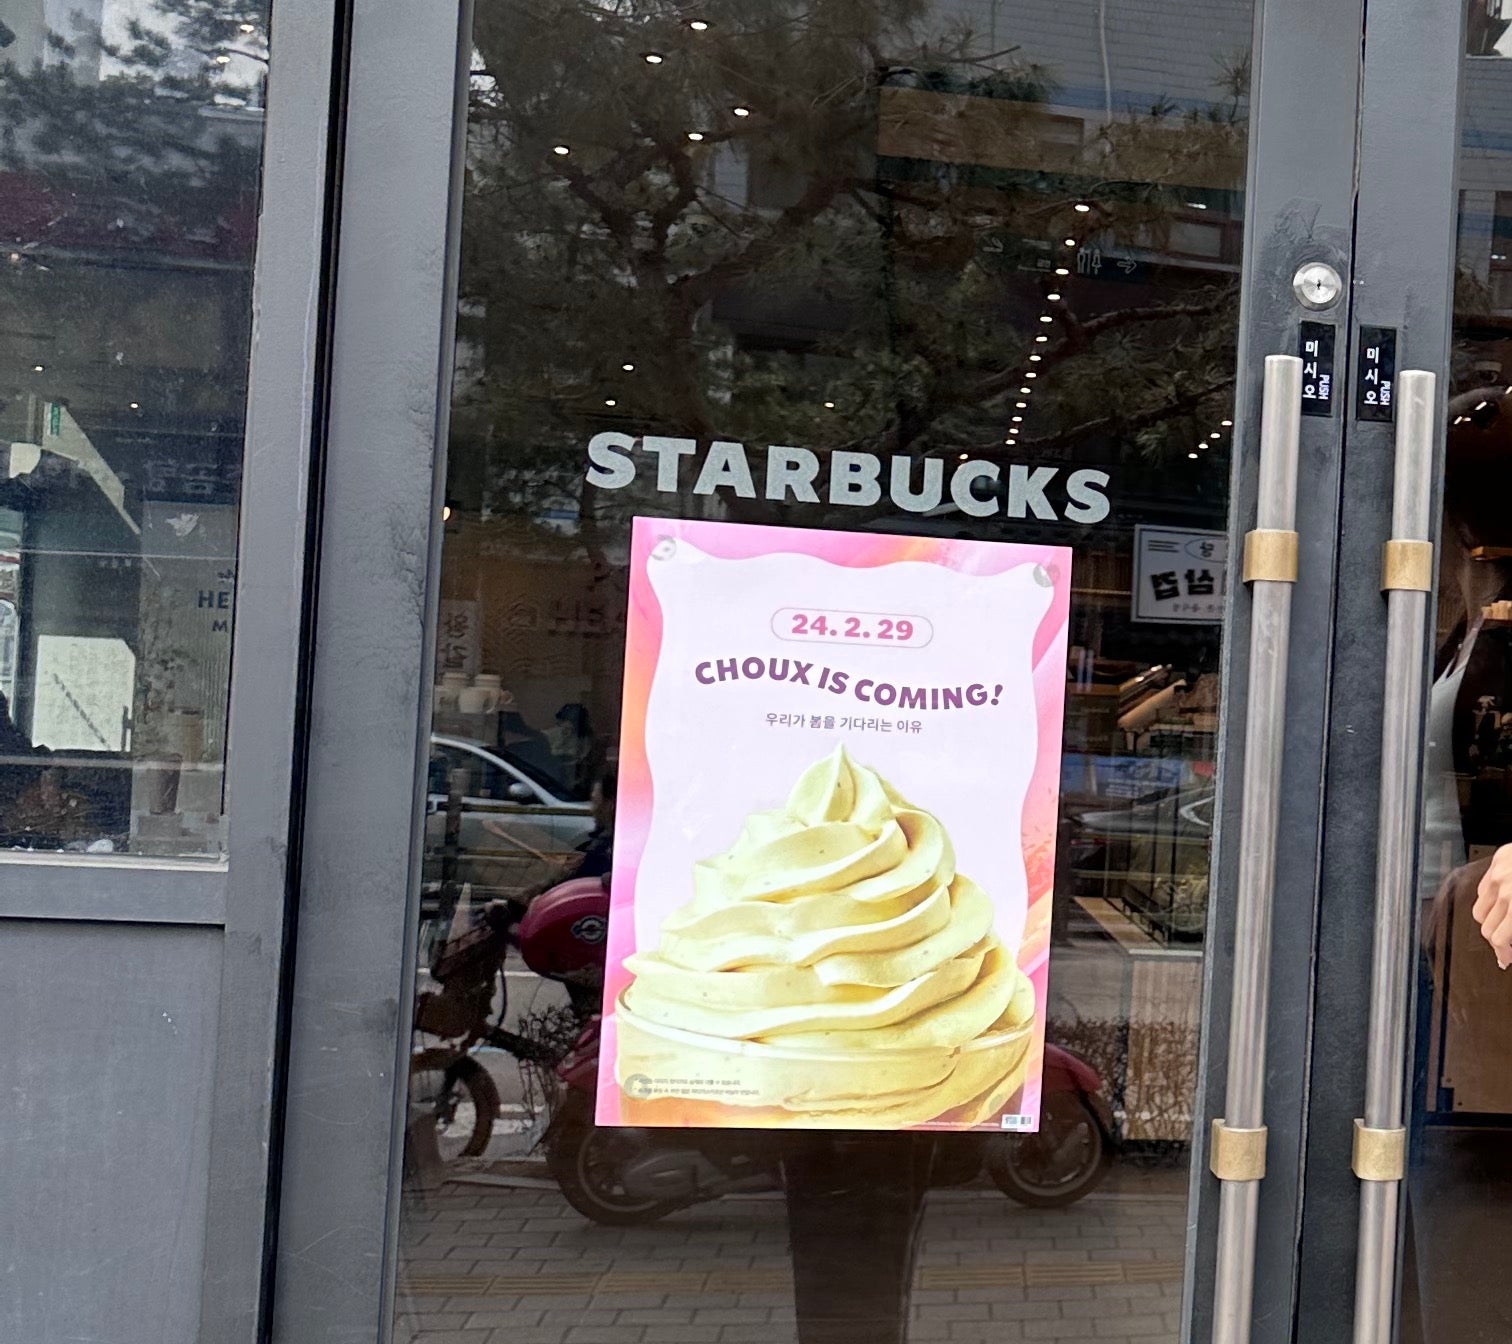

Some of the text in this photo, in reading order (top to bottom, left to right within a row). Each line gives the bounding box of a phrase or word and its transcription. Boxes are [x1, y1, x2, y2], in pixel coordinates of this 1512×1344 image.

[1302, 340, 1318, 399] 미시오
[1318, 374, 1330, 400] PUSH
[1364, 347, 1380, 405] 미시오
[1380, 380, 1391, 406] PUSH
[585, 431, 1111, 525] STARBUCKS
[695, 657, 1004, 710] CHOUX IS COMING!
[765, 712, 923, 734] 우리가 봄을 기다리는 이유
